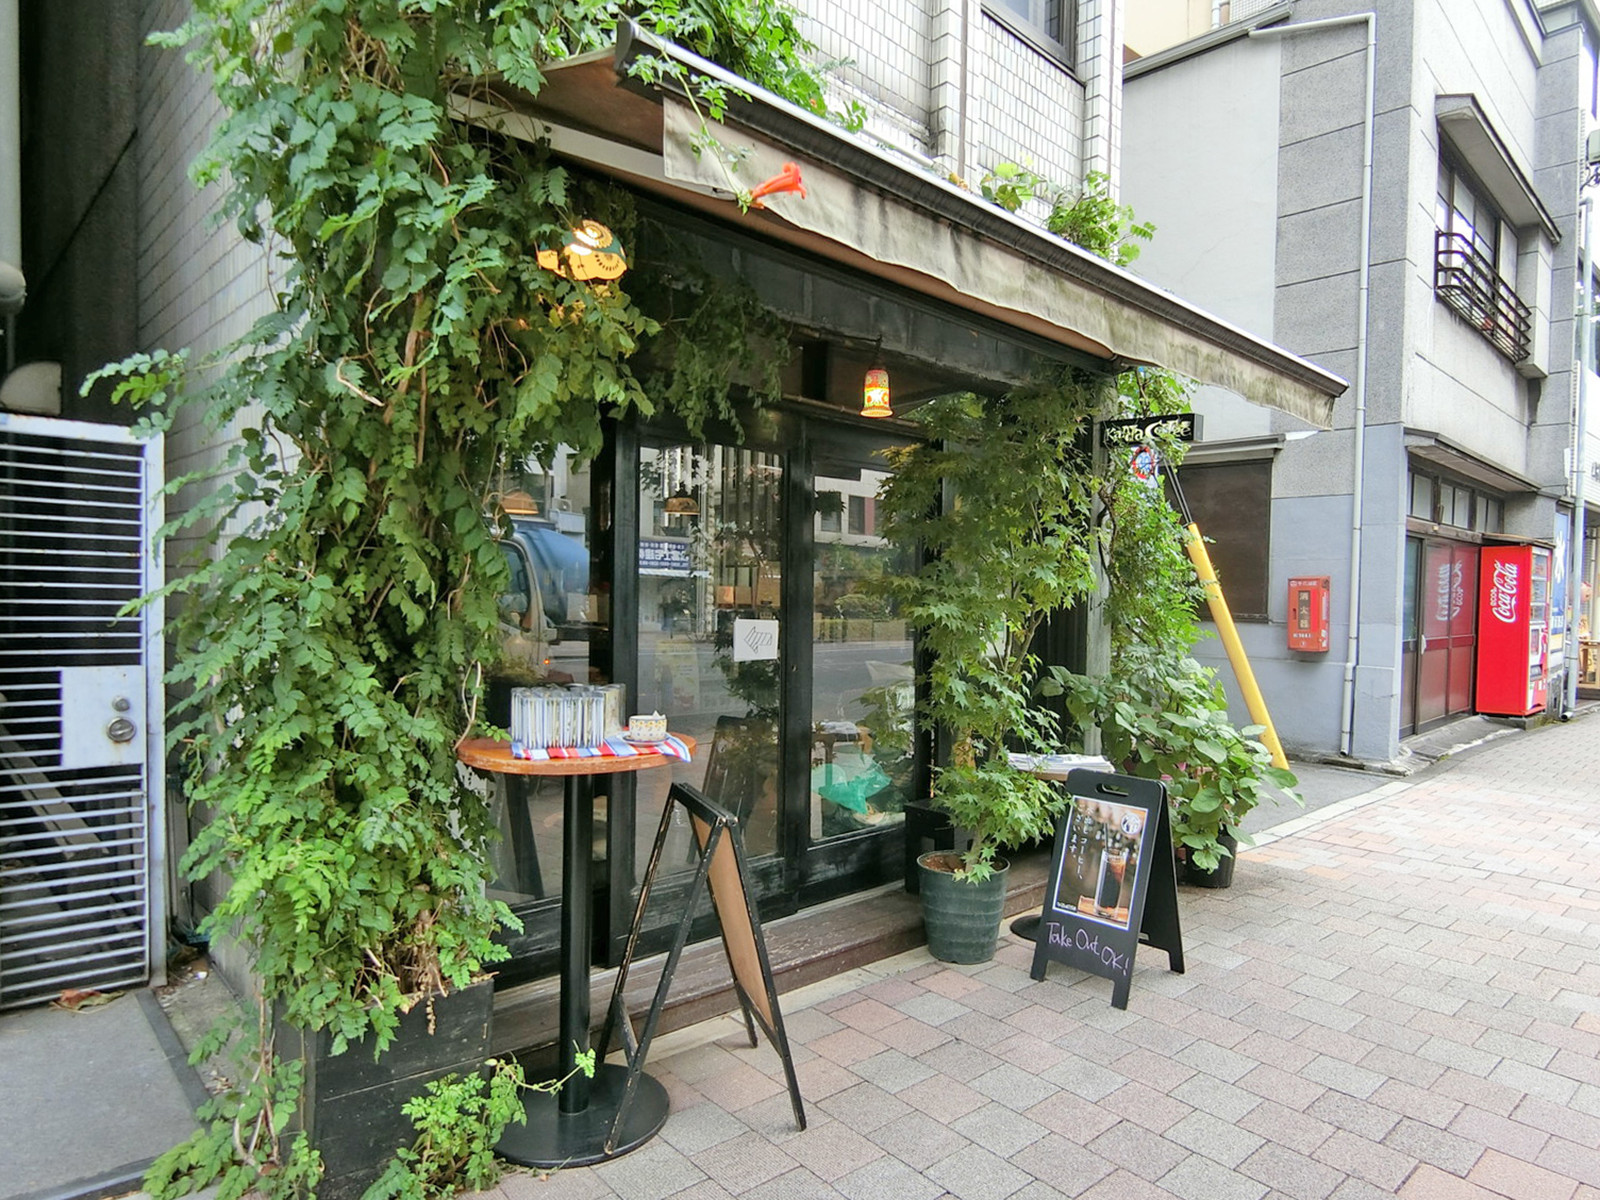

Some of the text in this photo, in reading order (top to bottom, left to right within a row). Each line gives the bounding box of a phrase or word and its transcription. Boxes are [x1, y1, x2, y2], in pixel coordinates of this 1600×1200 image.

[1299, 591, 1309, 628] 消火器
[1492, 559, 1518, 623] Coca-Cola
[1046, 922, 1129, 976] Take Out OK!
